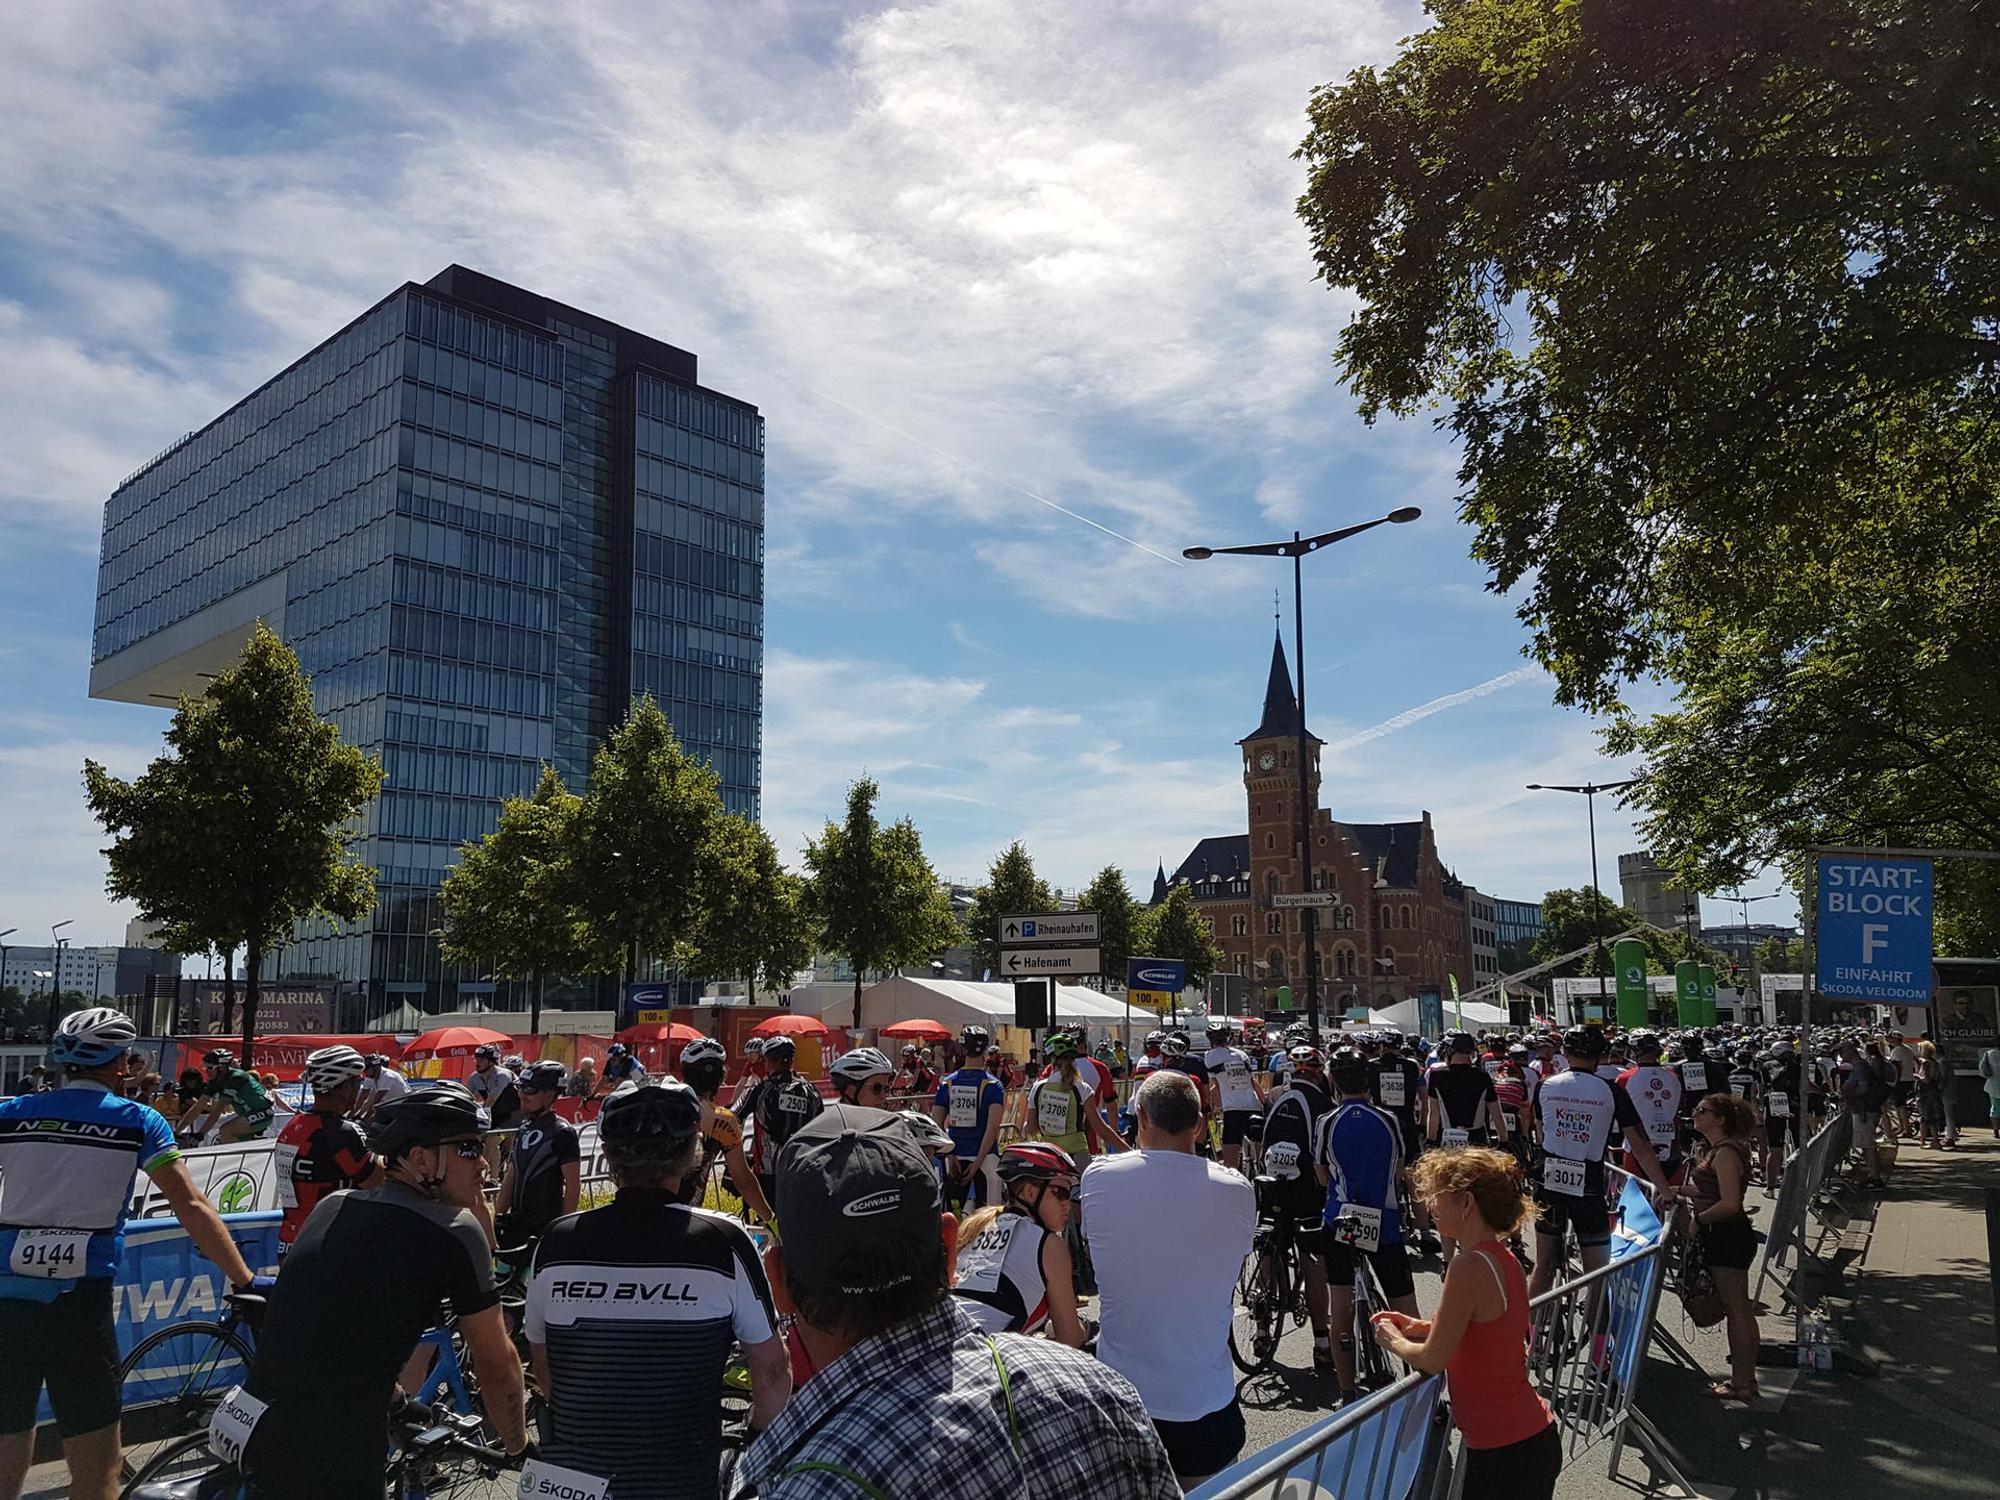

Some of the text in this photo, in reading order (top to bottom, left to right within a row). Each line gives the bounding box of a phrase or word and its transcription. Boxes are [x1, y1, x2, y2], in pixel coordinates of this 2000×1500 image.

[1827, 865, 1924, 889] START-
[1828, 892, 1922, 917] BLOCK
[1038, 922, 1095, 935] Rheinauhafen
[1862, 923, 1889, 964] F
[1023, 957, 1072, 968] Hafenamt
[1835, 967, 1914, 984] EINFAHRT
[262, 991, 325, 1005] MARINA
[1136, 993, 1152, 1003] 100
[1866, 986, 1928, 999] VELODOM
[256, 1010, 281, 1018] 0221
[1046, 1102, 1067, 1117] 3708
[1272, 1152, 1296, 1166] 3205
[1554, 1169, 1584, 1187] 3017
[852, 1194, 901, 1212] SCHWALBE
[971, 1228, 1011, 1251] 3829
[21, 1243, 76, 1265] 9144
[47, 1267, 58, 1278] F
[551, 1280, 699, 1301] RED BVLL
[538, 1478, 597, 1500] ŠKODA
